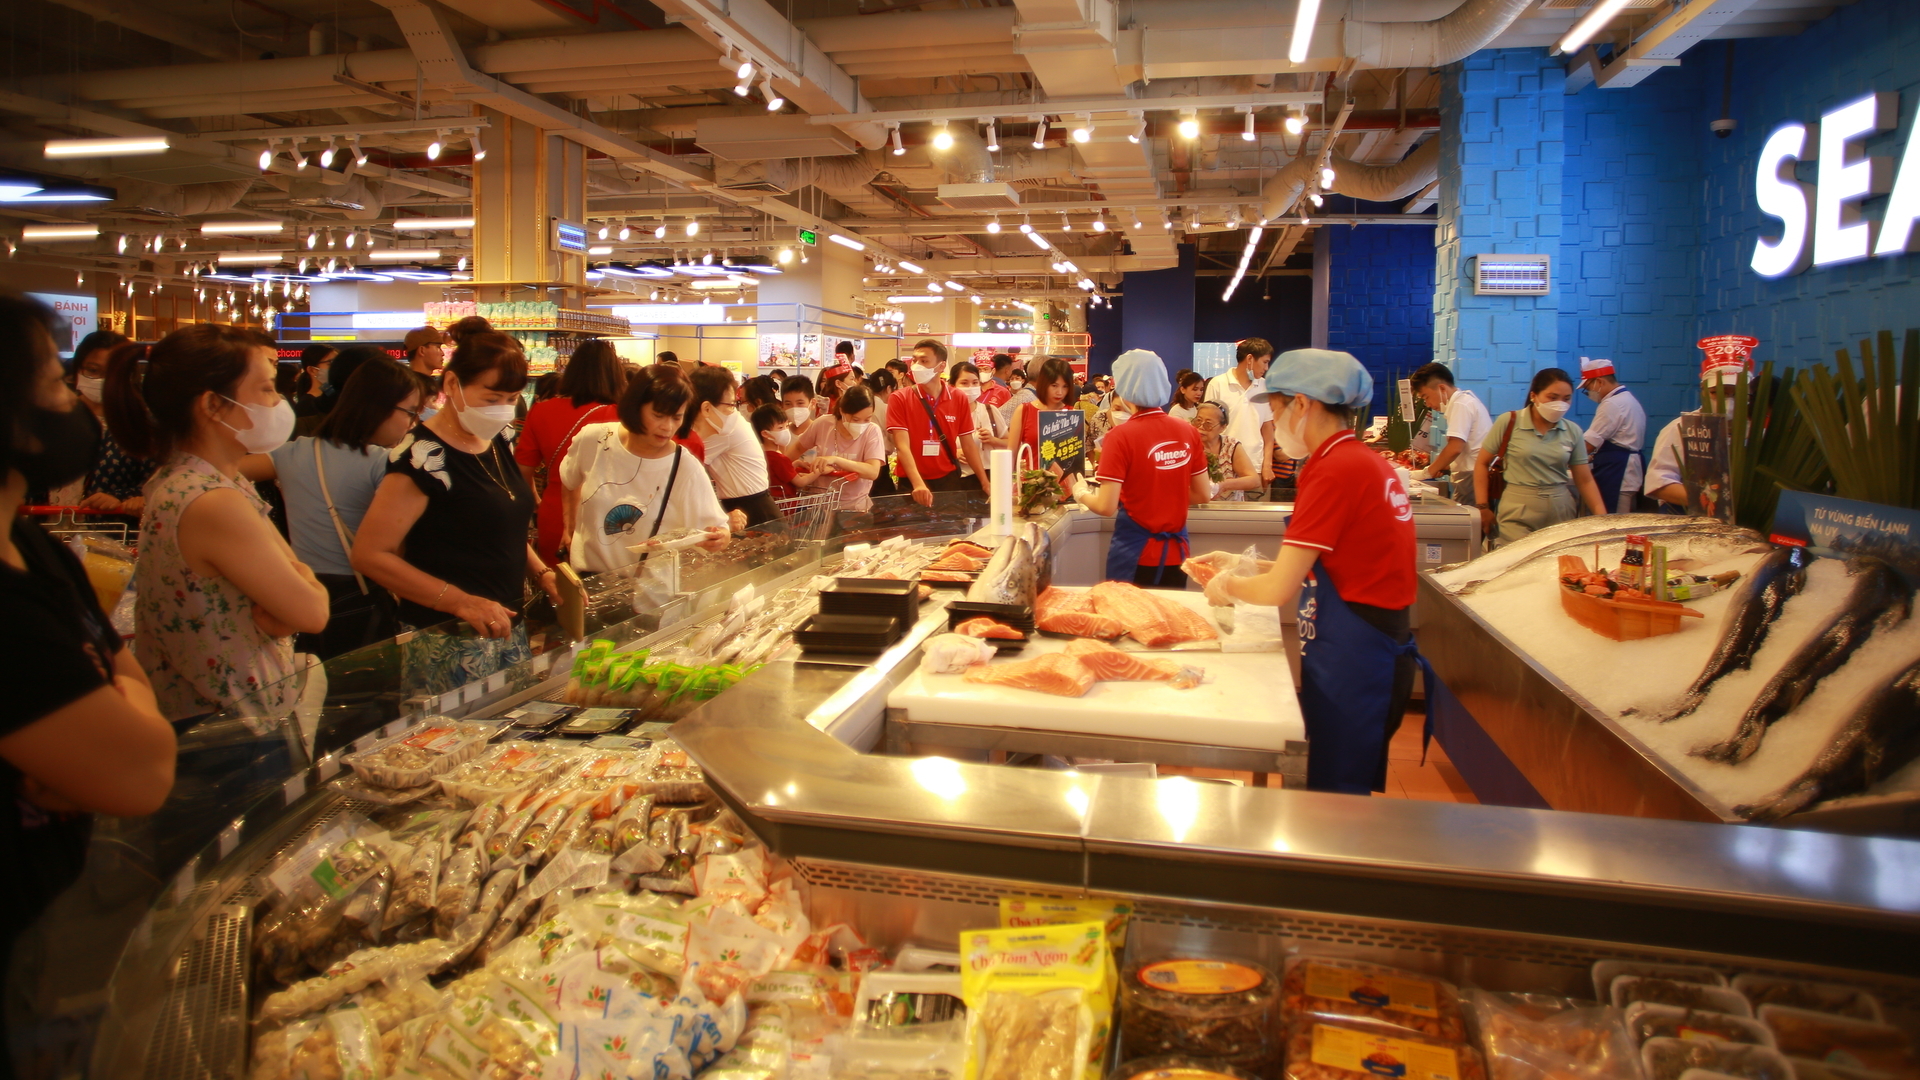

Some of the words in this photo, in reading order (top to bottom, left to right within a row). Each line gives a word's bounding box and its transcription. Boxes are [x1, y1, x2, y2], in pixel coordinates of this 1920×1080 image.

[54, 300, 88, 312] BÁNH
[1687, 425, 1697, 438] CÁ
[1697, 424, 1711, 439] HỒI
[1687, 441, 1698, 452] NA
[1699, 442, 1710, 453] UY
[1154, 450, 1187, 462] Vimex
[1814, 507, 1826, 520] TỪ
[1828, 510, 1854, 525] VÙNG
[1879, 520, 1910, 536] LẠNH
[1809, 523, 1822, 535] NA
[1824, 525, 1839, 538] UY
[1031, 950, 1068, 968] Ngon
